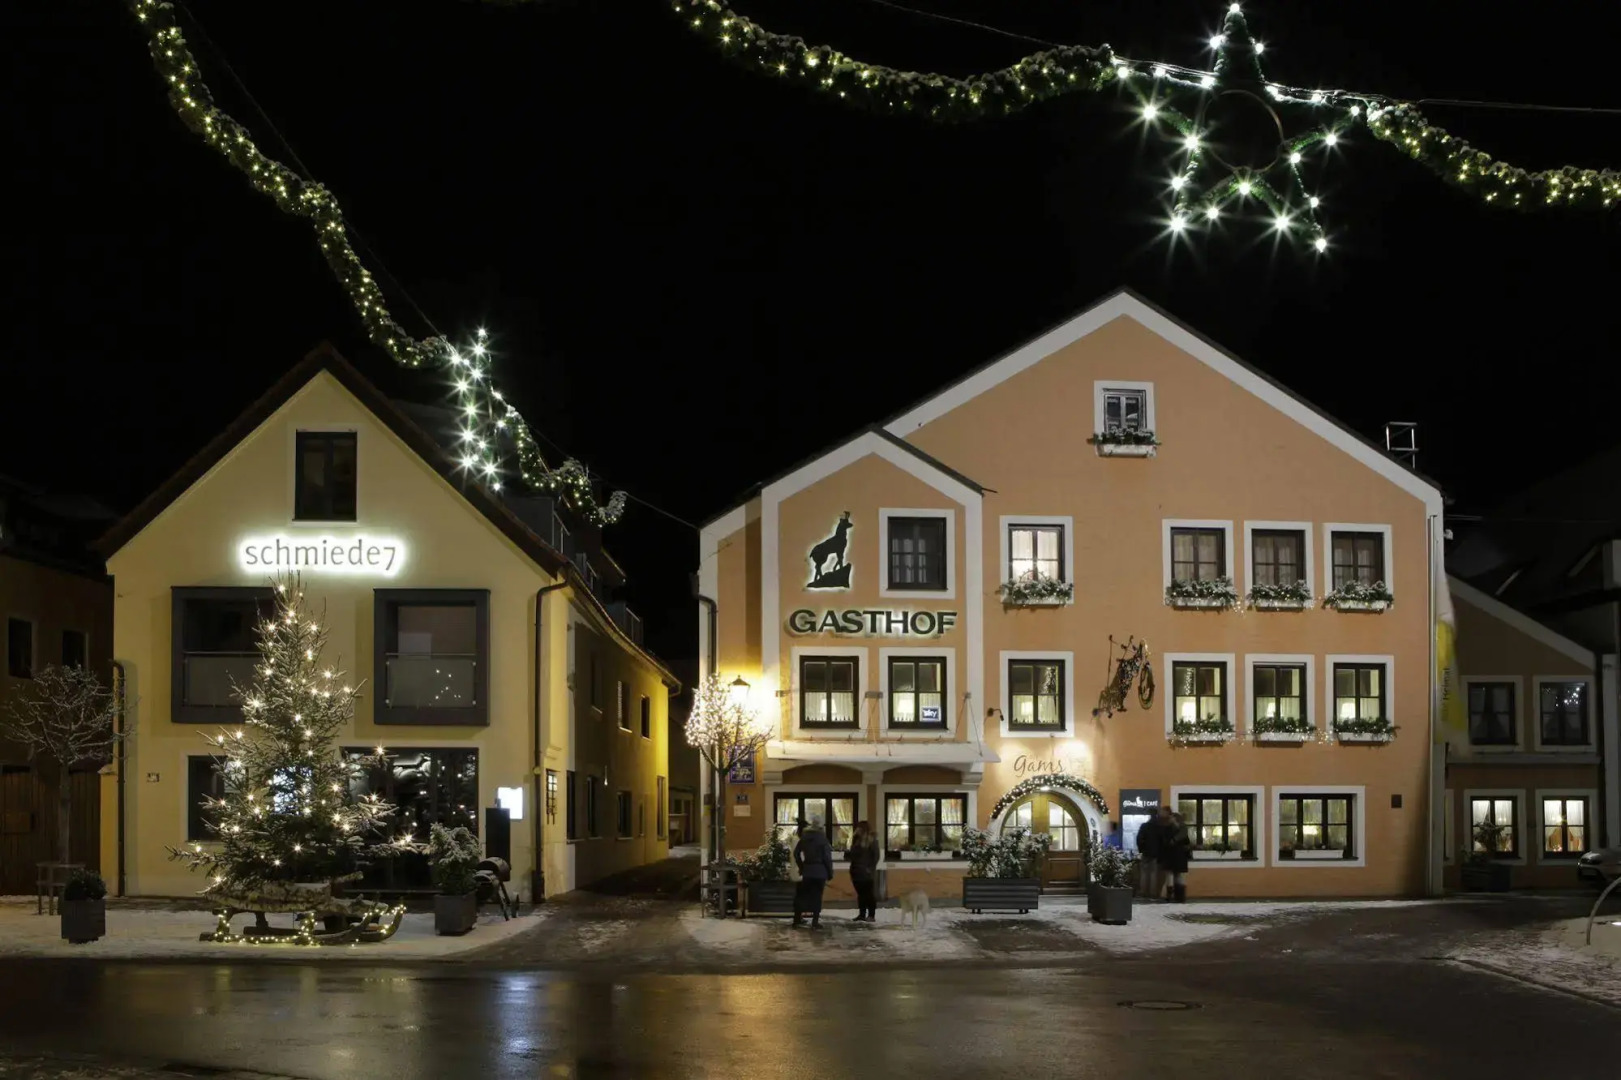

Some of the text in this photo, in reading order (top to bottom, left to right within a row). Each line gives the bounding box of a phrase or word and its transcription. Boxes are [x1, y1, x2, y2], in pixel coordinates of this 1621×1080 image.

[245, 538, 396, 571] schmiede7
[788, 608, 958, 636] GASTHOF
[1013, 754, 1066, 778] Gams
